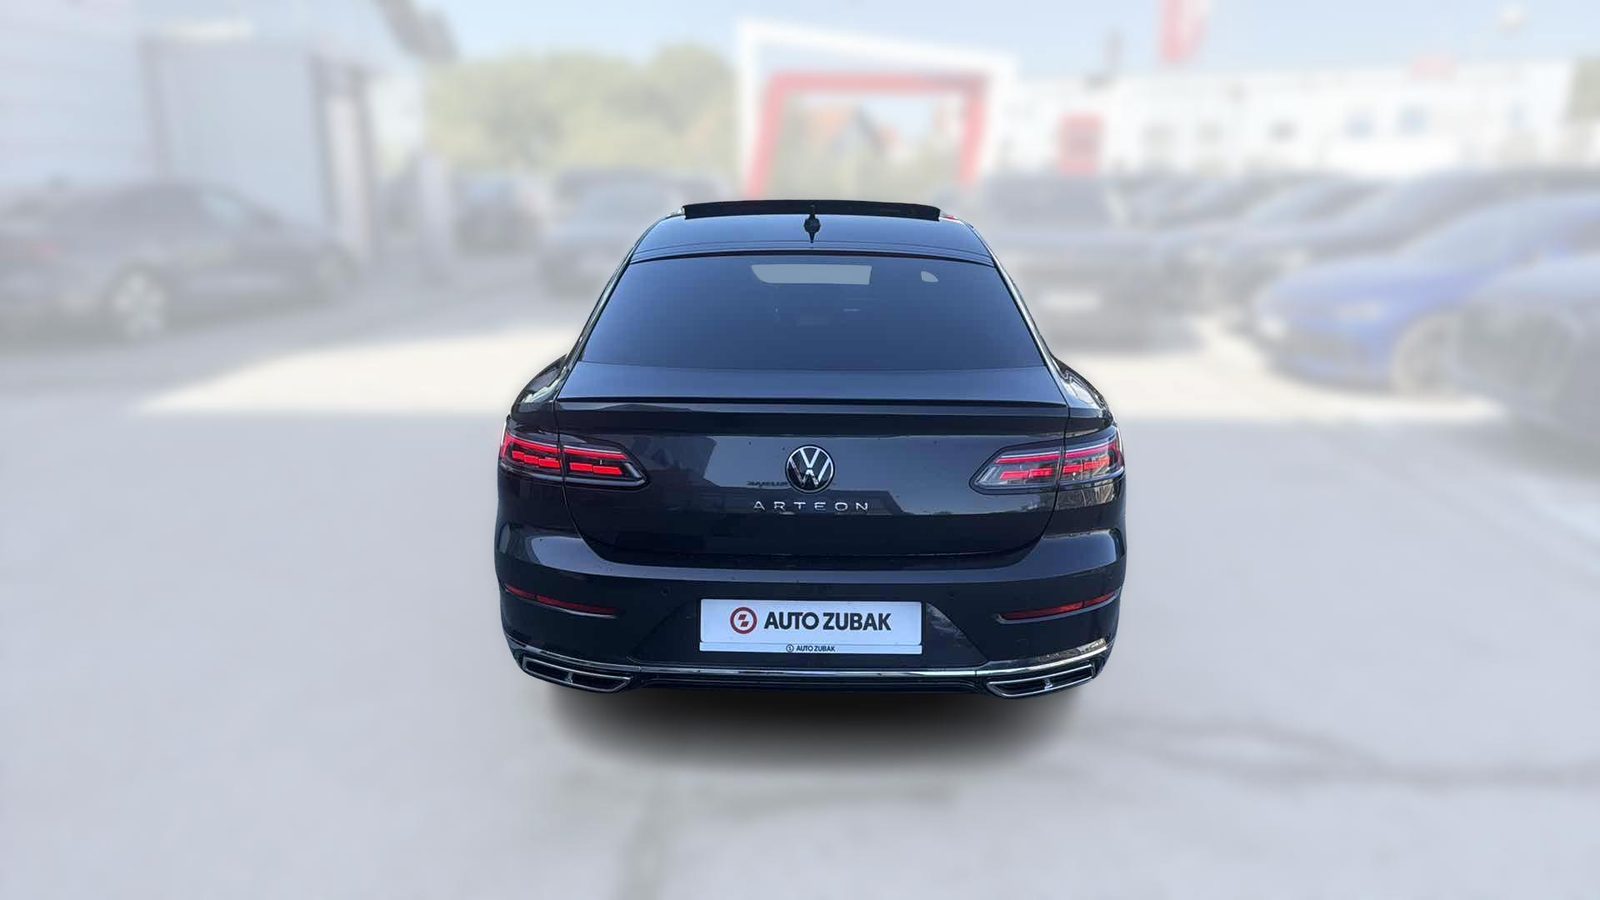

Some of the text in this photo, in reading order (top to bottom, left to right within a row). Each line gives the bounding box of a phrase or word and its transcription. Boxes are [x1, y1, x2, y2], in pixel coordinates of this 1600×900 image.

[753, 501, 869, 511] ARTEON
[764, 611, 892, 631] AUTO ZUBAK
[796, 644, 814, 652] AUTO
